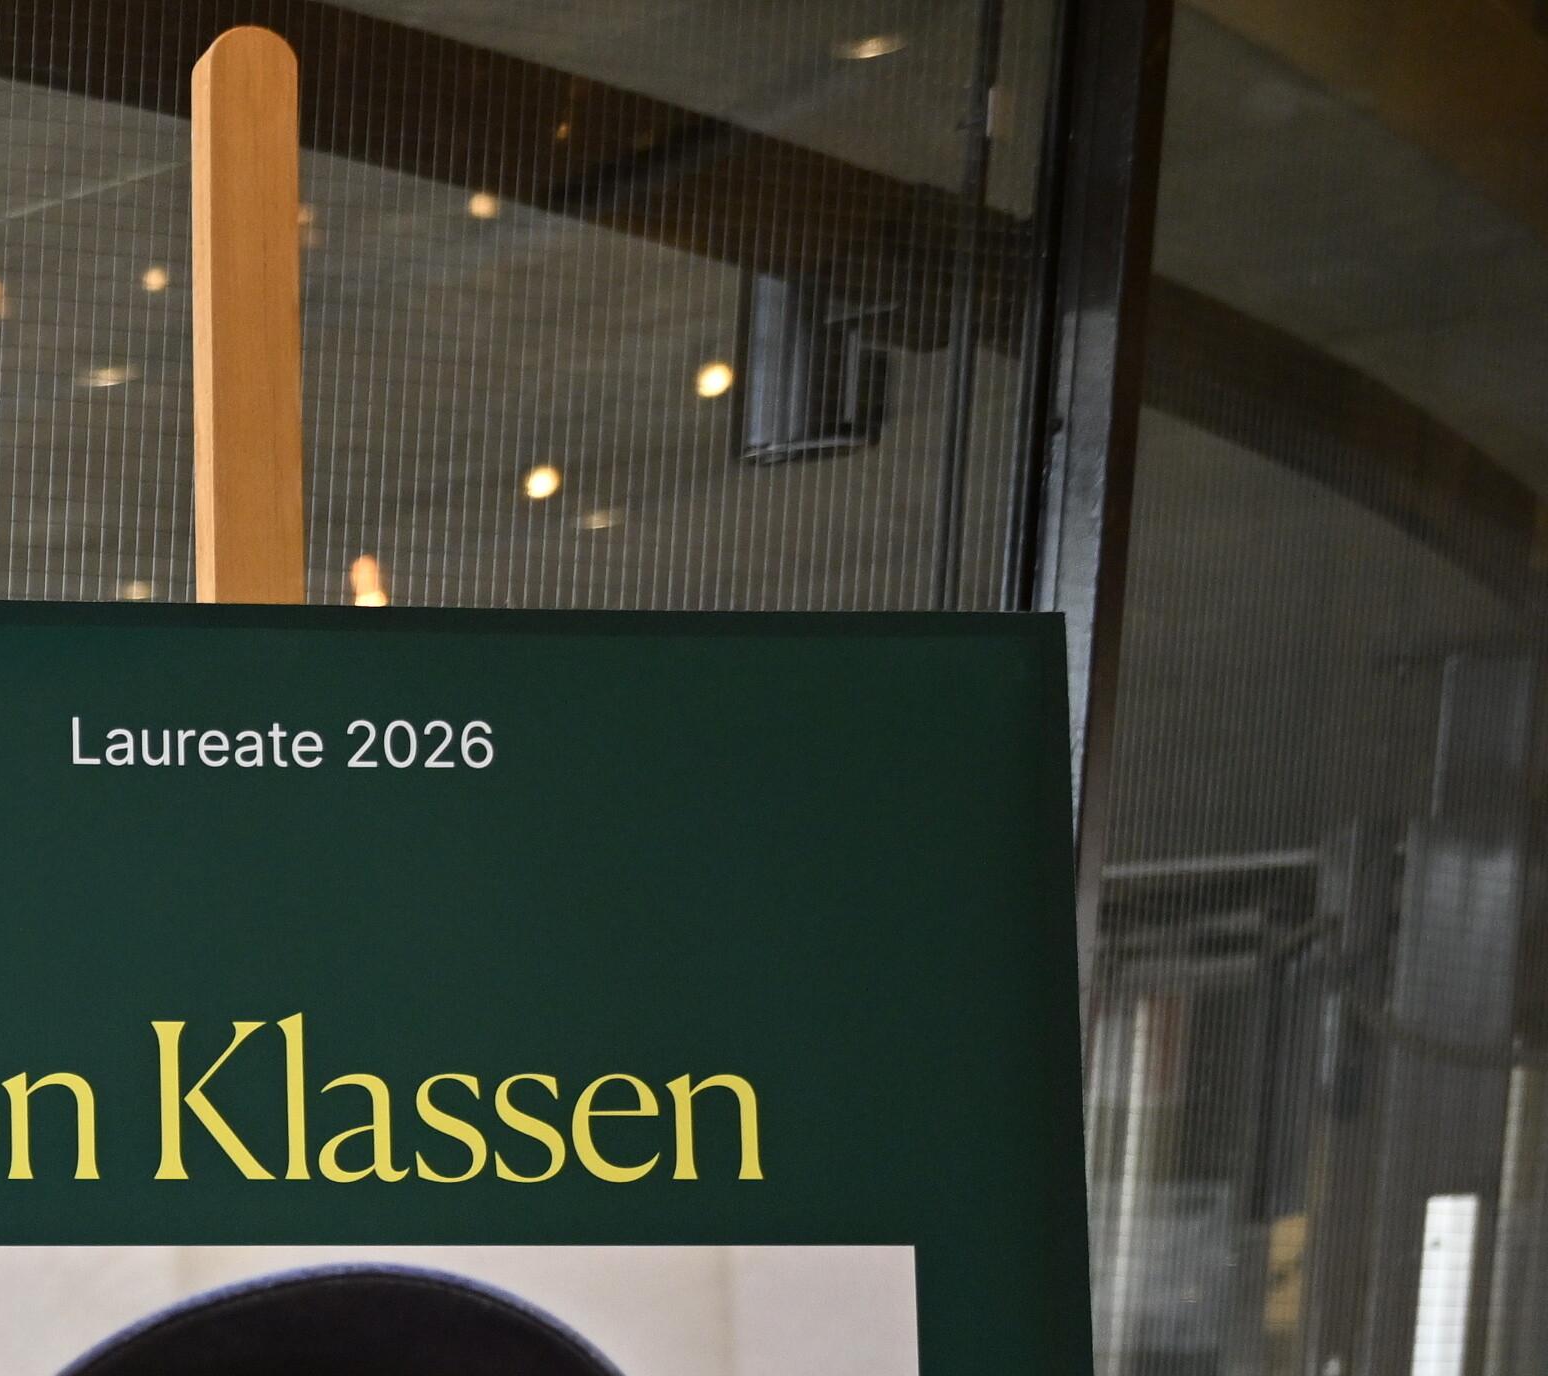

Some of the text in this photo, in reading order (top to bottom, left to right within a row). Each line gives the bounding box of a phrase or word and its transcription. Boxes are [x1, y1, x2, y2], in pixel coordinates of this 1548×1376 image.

[72, 716, 494, 769] Laureate 2026
[150, 1011, 764, 1183] Klassen
